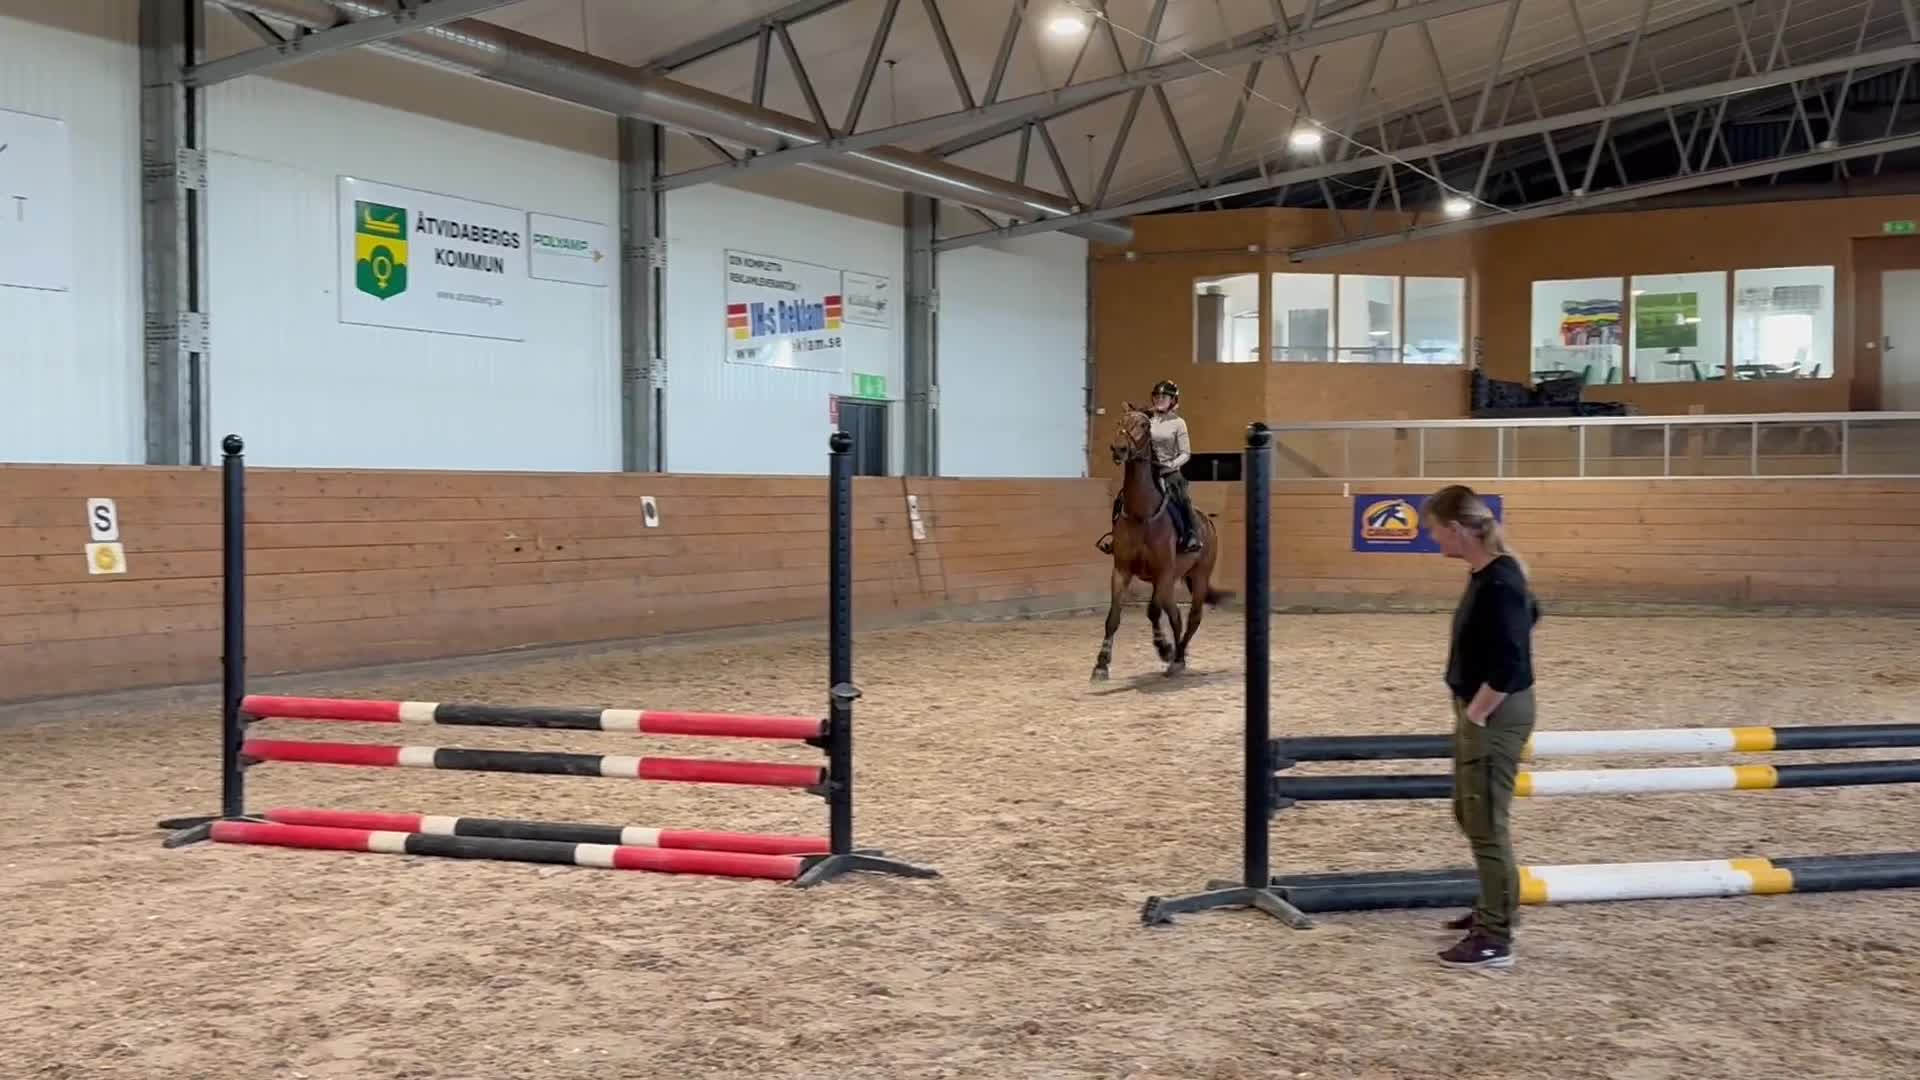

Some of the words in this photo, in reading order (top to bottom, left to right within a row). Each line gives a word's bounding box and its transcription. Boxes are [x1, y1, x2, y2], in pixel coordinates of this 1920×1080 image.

[416, 210, 520, 249] ÅTVIDABERGS
[434, 248, 504, 274] KOMMUN
[94, 504, 112, 533] S
